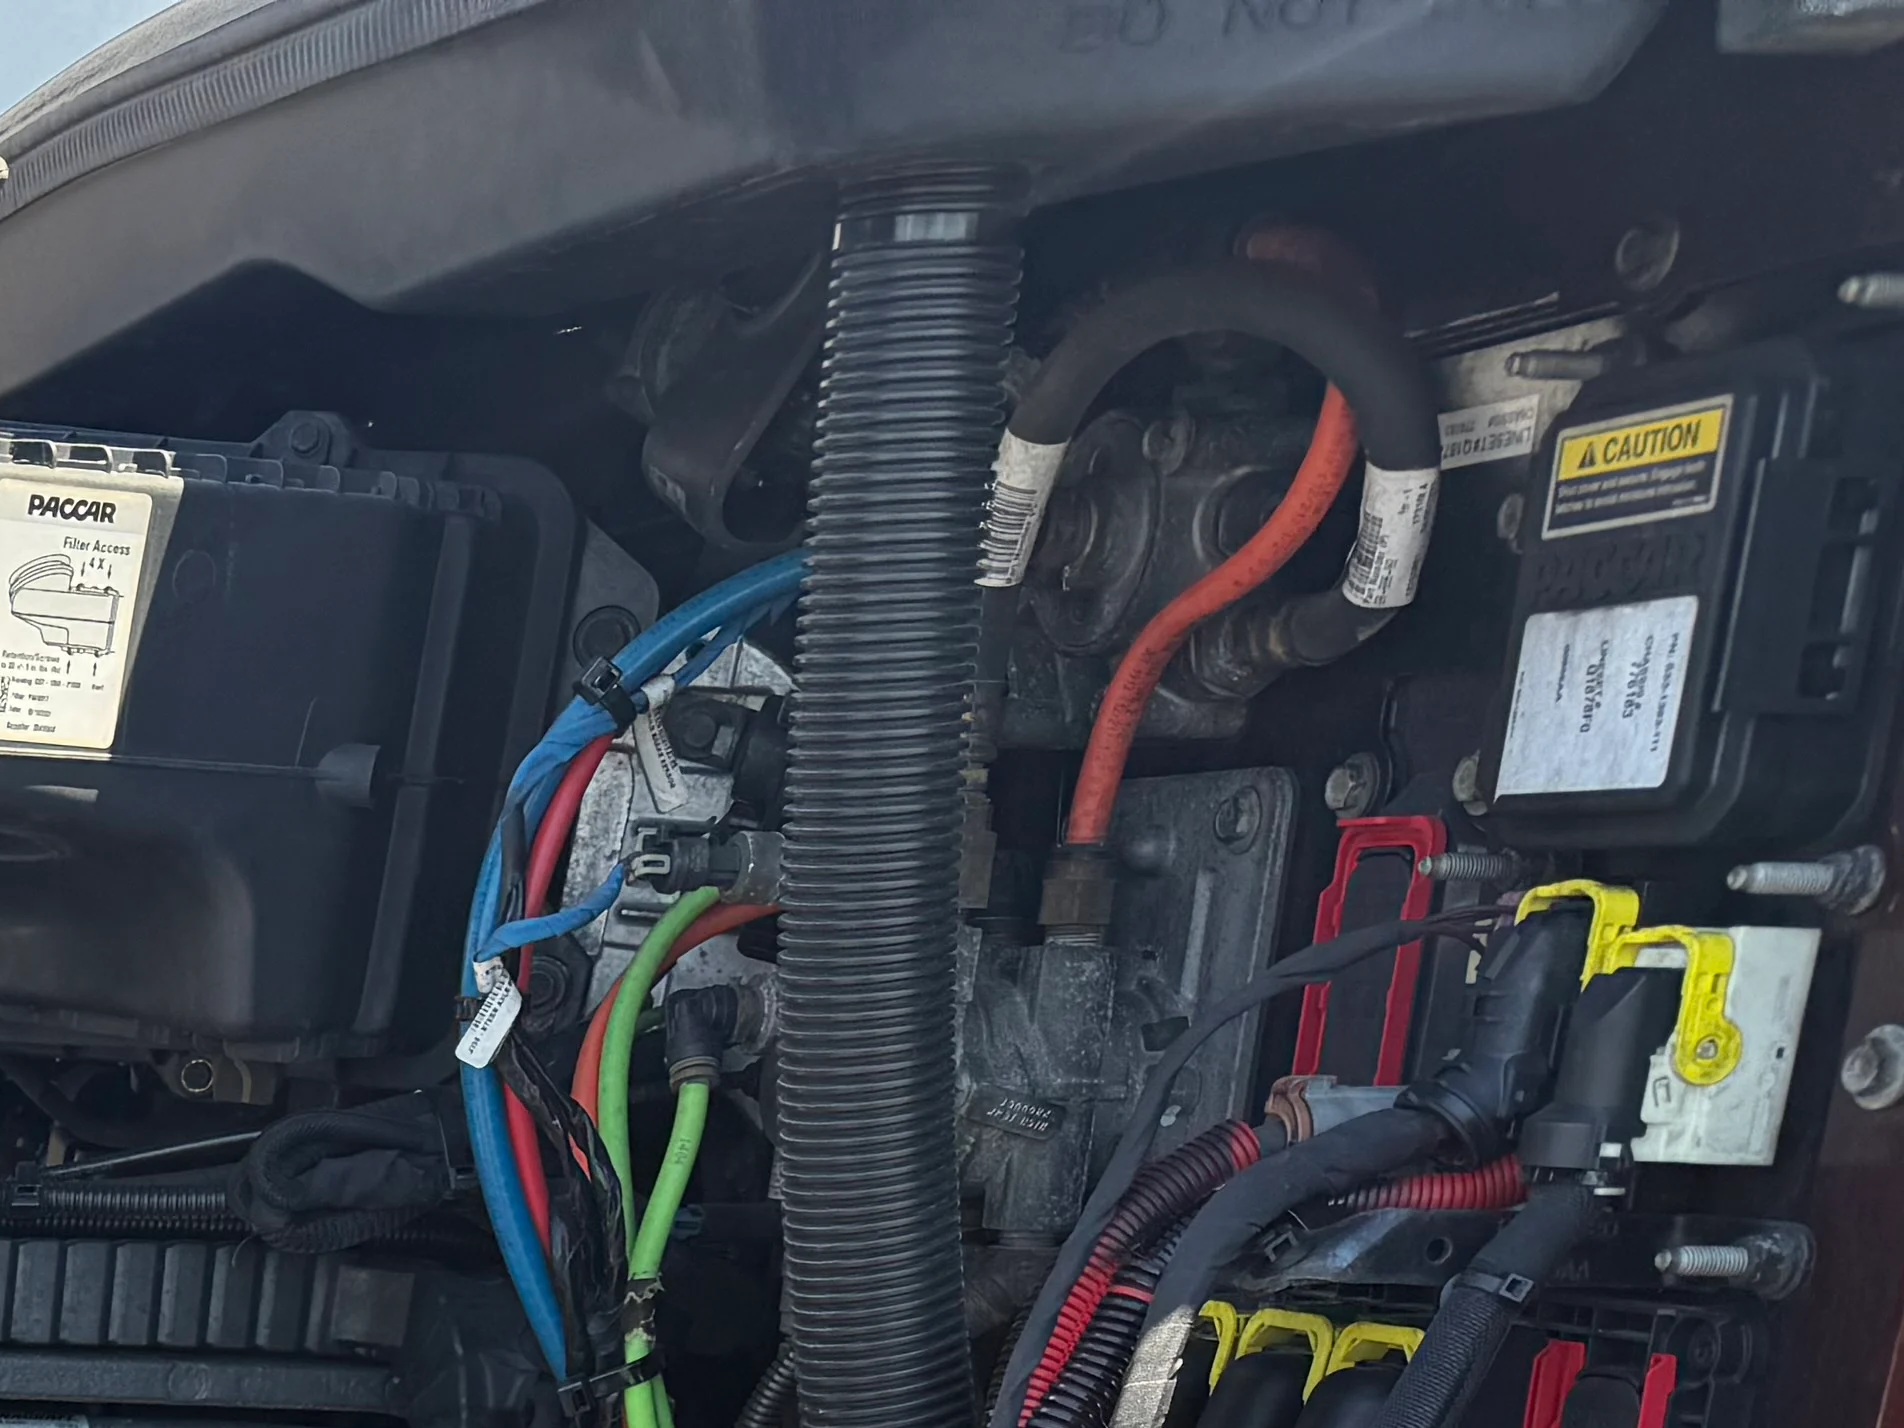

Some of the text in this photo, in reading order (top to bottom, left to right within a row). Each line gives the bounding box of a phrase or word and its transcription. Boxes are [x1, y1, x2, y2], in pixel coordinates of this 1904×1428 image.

[1602, 420, 1702, 464] CAUTION
[27, 494, 116, 524] PACCAR
[63, 536, 131, 556] Filter Access
